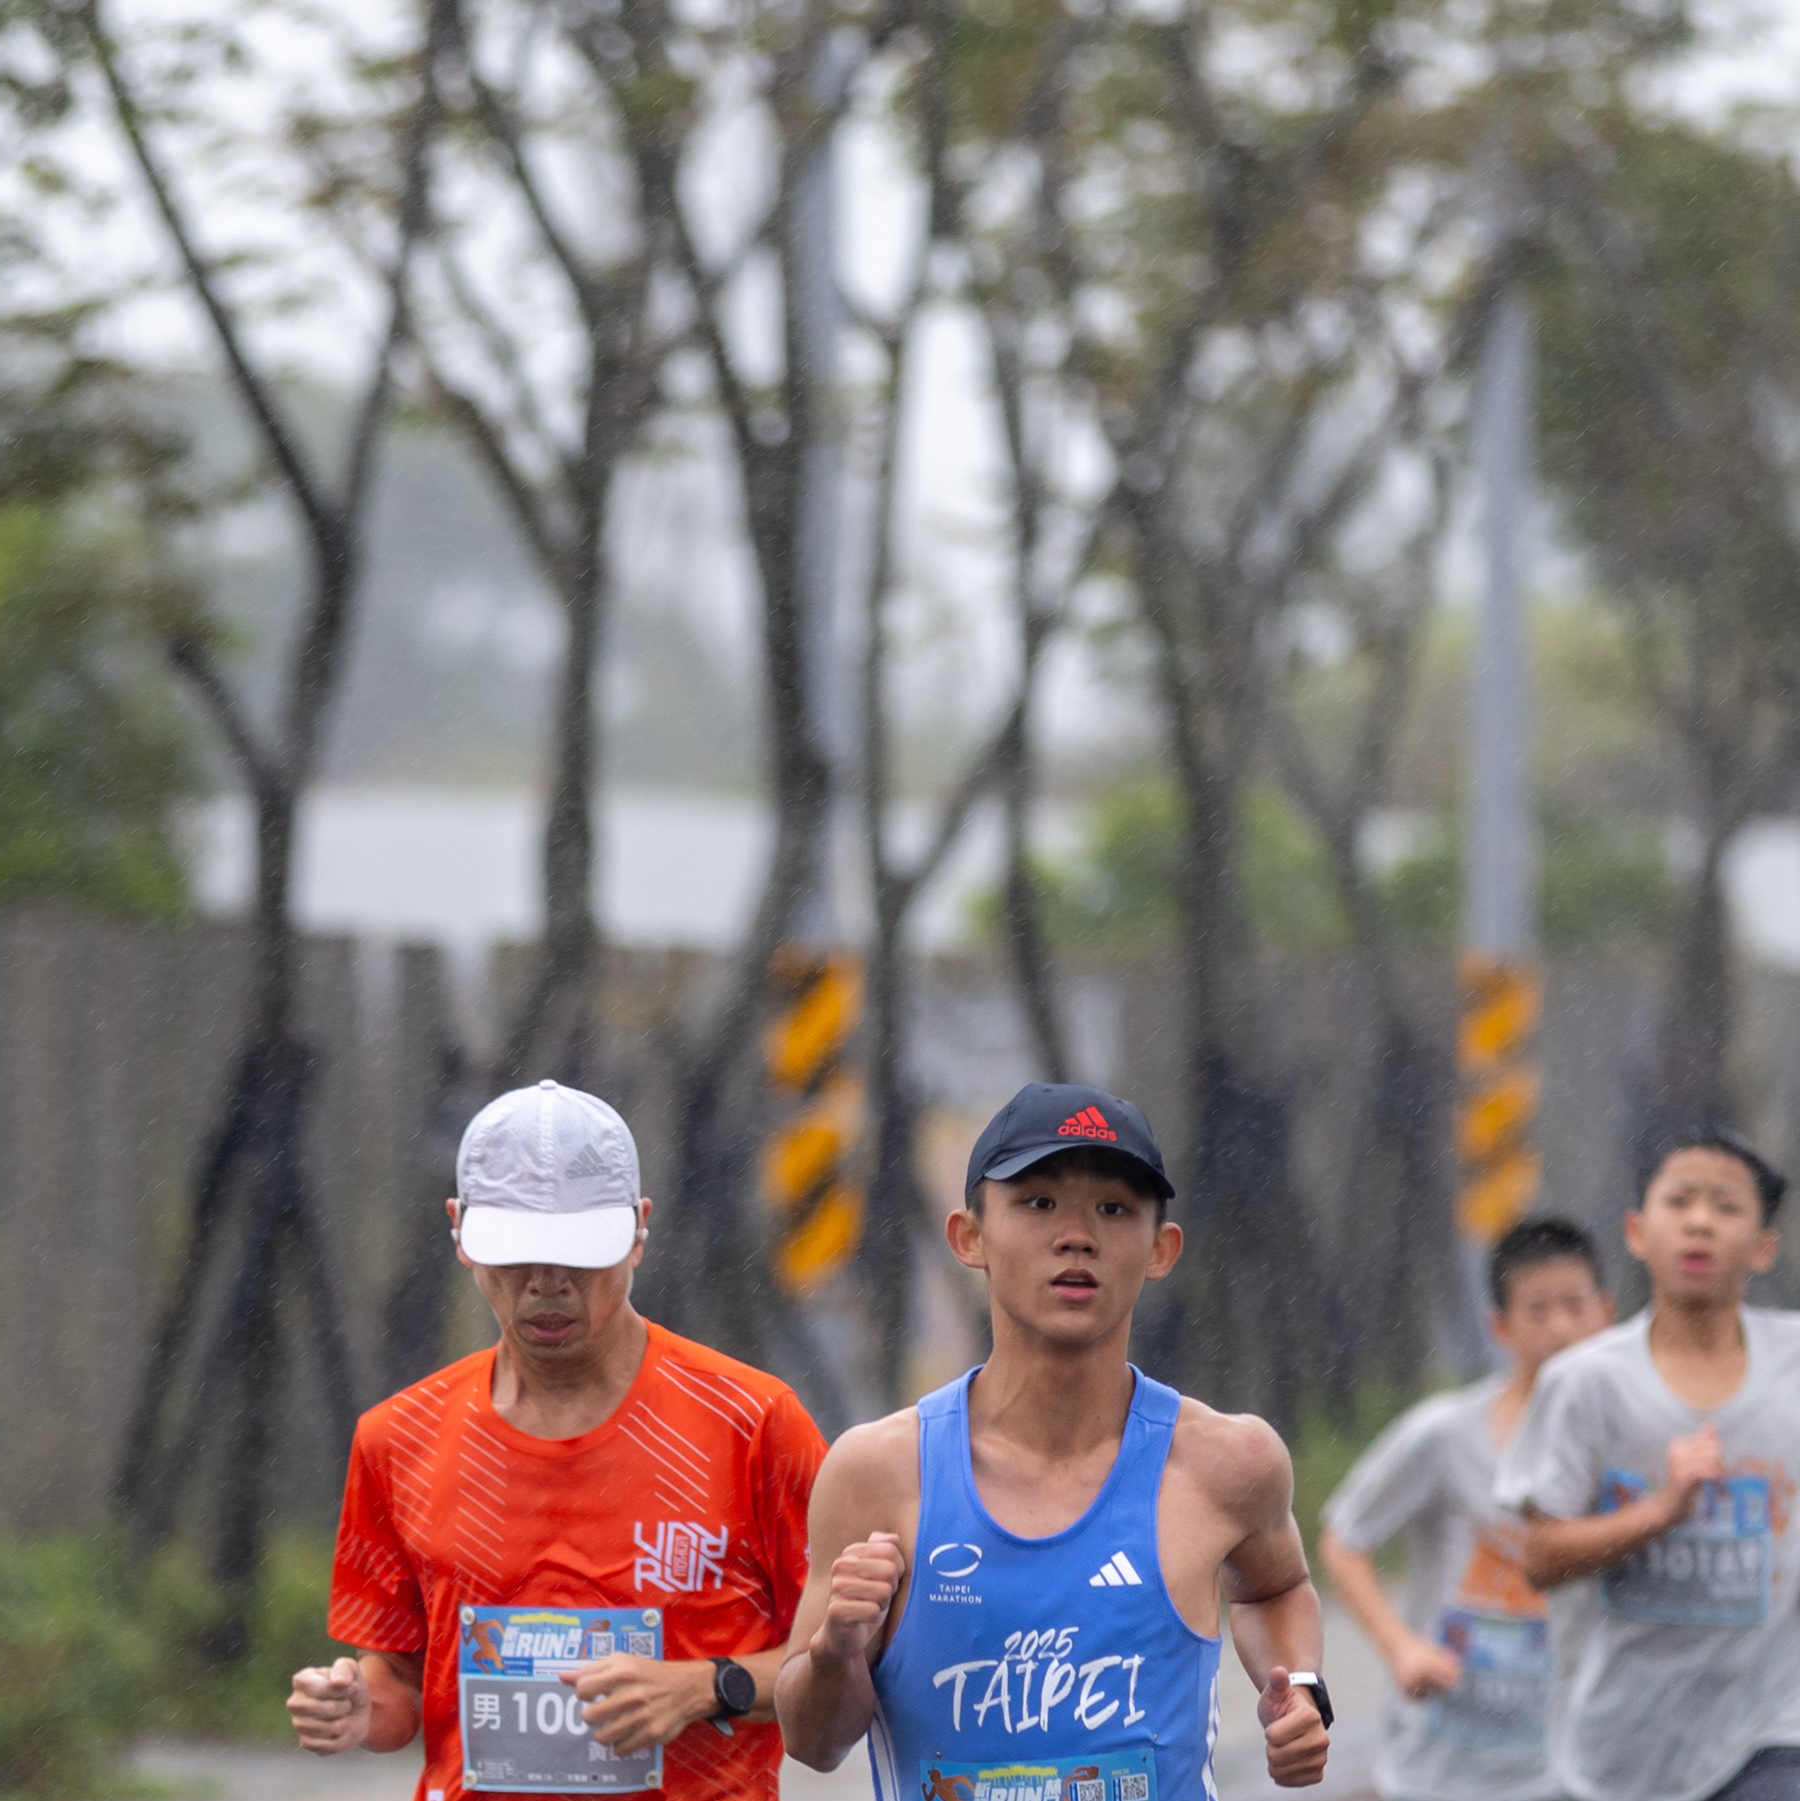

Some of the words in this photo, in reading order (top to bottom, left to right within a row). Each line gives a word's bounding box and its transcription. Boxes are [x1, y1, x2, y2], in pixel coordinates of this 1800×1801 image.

[1057, 1124, 1118, 1142] adidas
[929, 1593, 983, 1604] MARATHON
[939, 1583, 971, 1593] TAIPEI
[516, 1632, 566, 1659] RUN
[1004, 1626, 1079, 1661] 2025
[932, 1653, 1146, 1734] TAIPEI
[472, 1693, 500, 1731] 男
